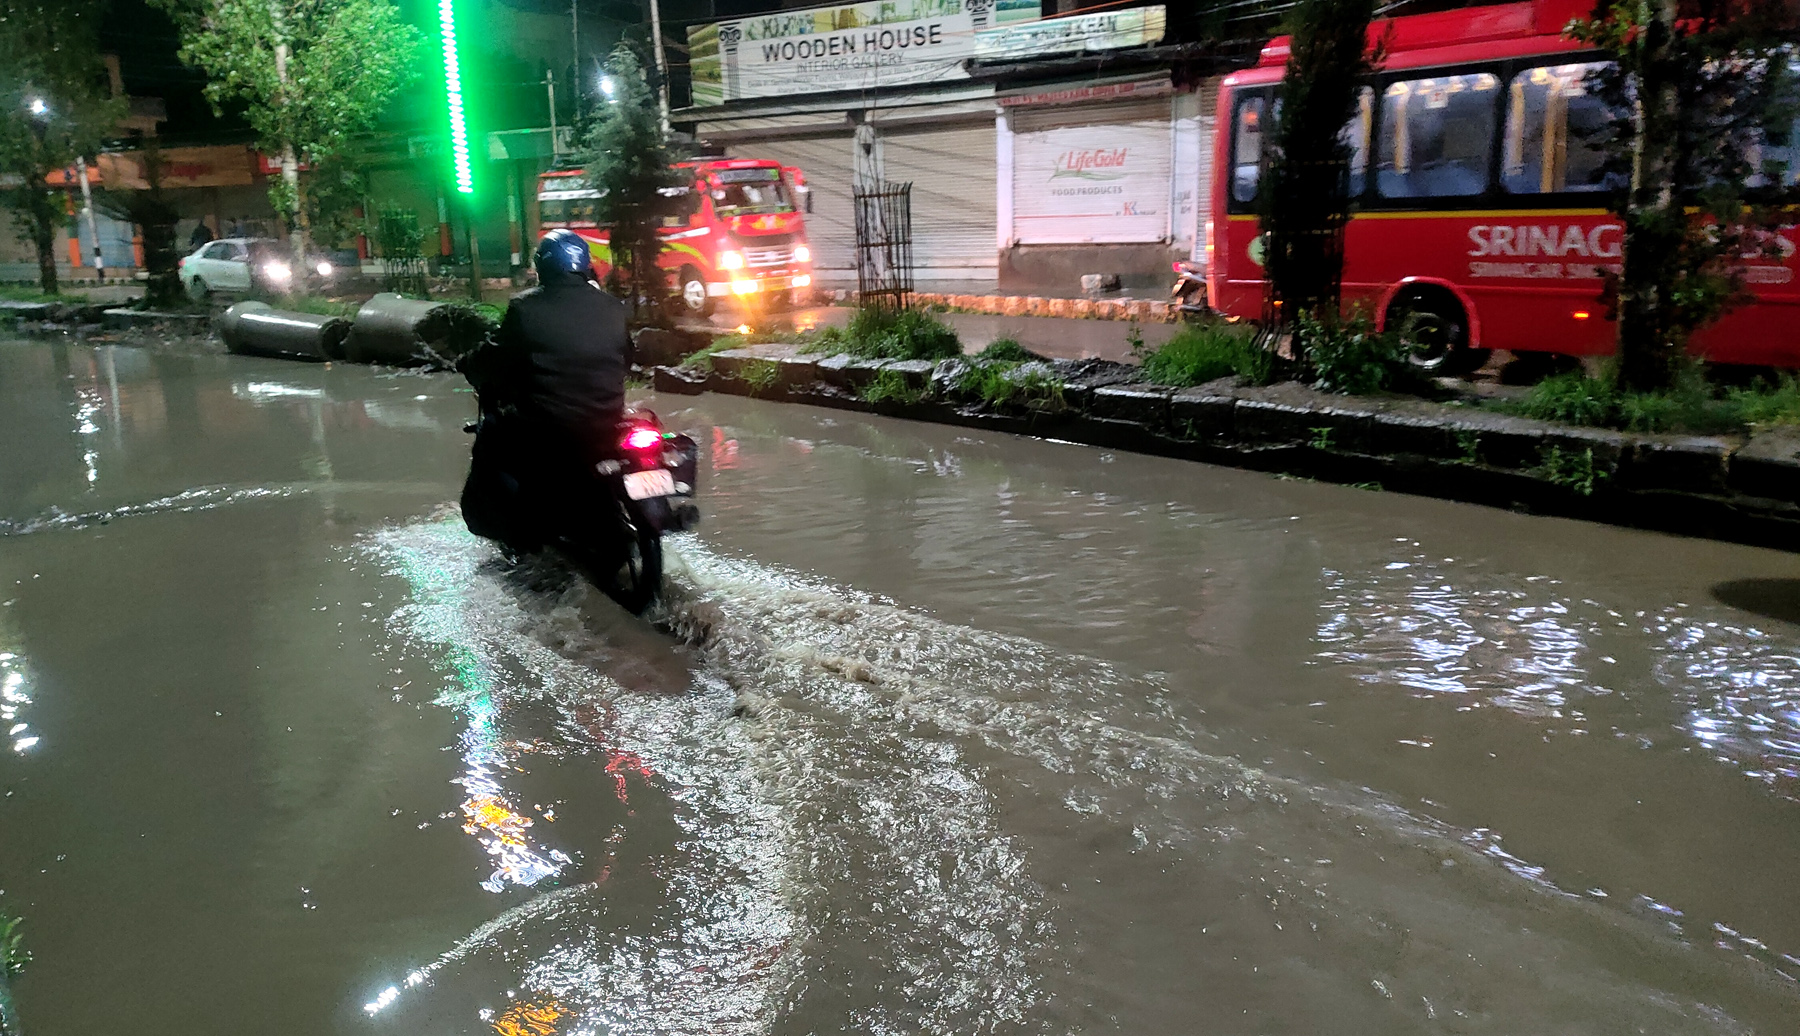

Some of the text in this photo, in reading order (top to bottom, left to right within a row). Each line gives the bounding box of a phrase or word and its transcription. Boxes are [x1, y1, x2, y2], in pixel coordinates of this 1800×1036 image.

[762, 24, 942, 62] WOODEN HOUSE
[798, 52, 905, 73] INTERIOR GALLERY
[1066, 148, 1127, 173] LifeGold
[1052, 186, 1123, 196] FOOD PRODUCTS
[1467, 224, 1622, 258] SRINAG
